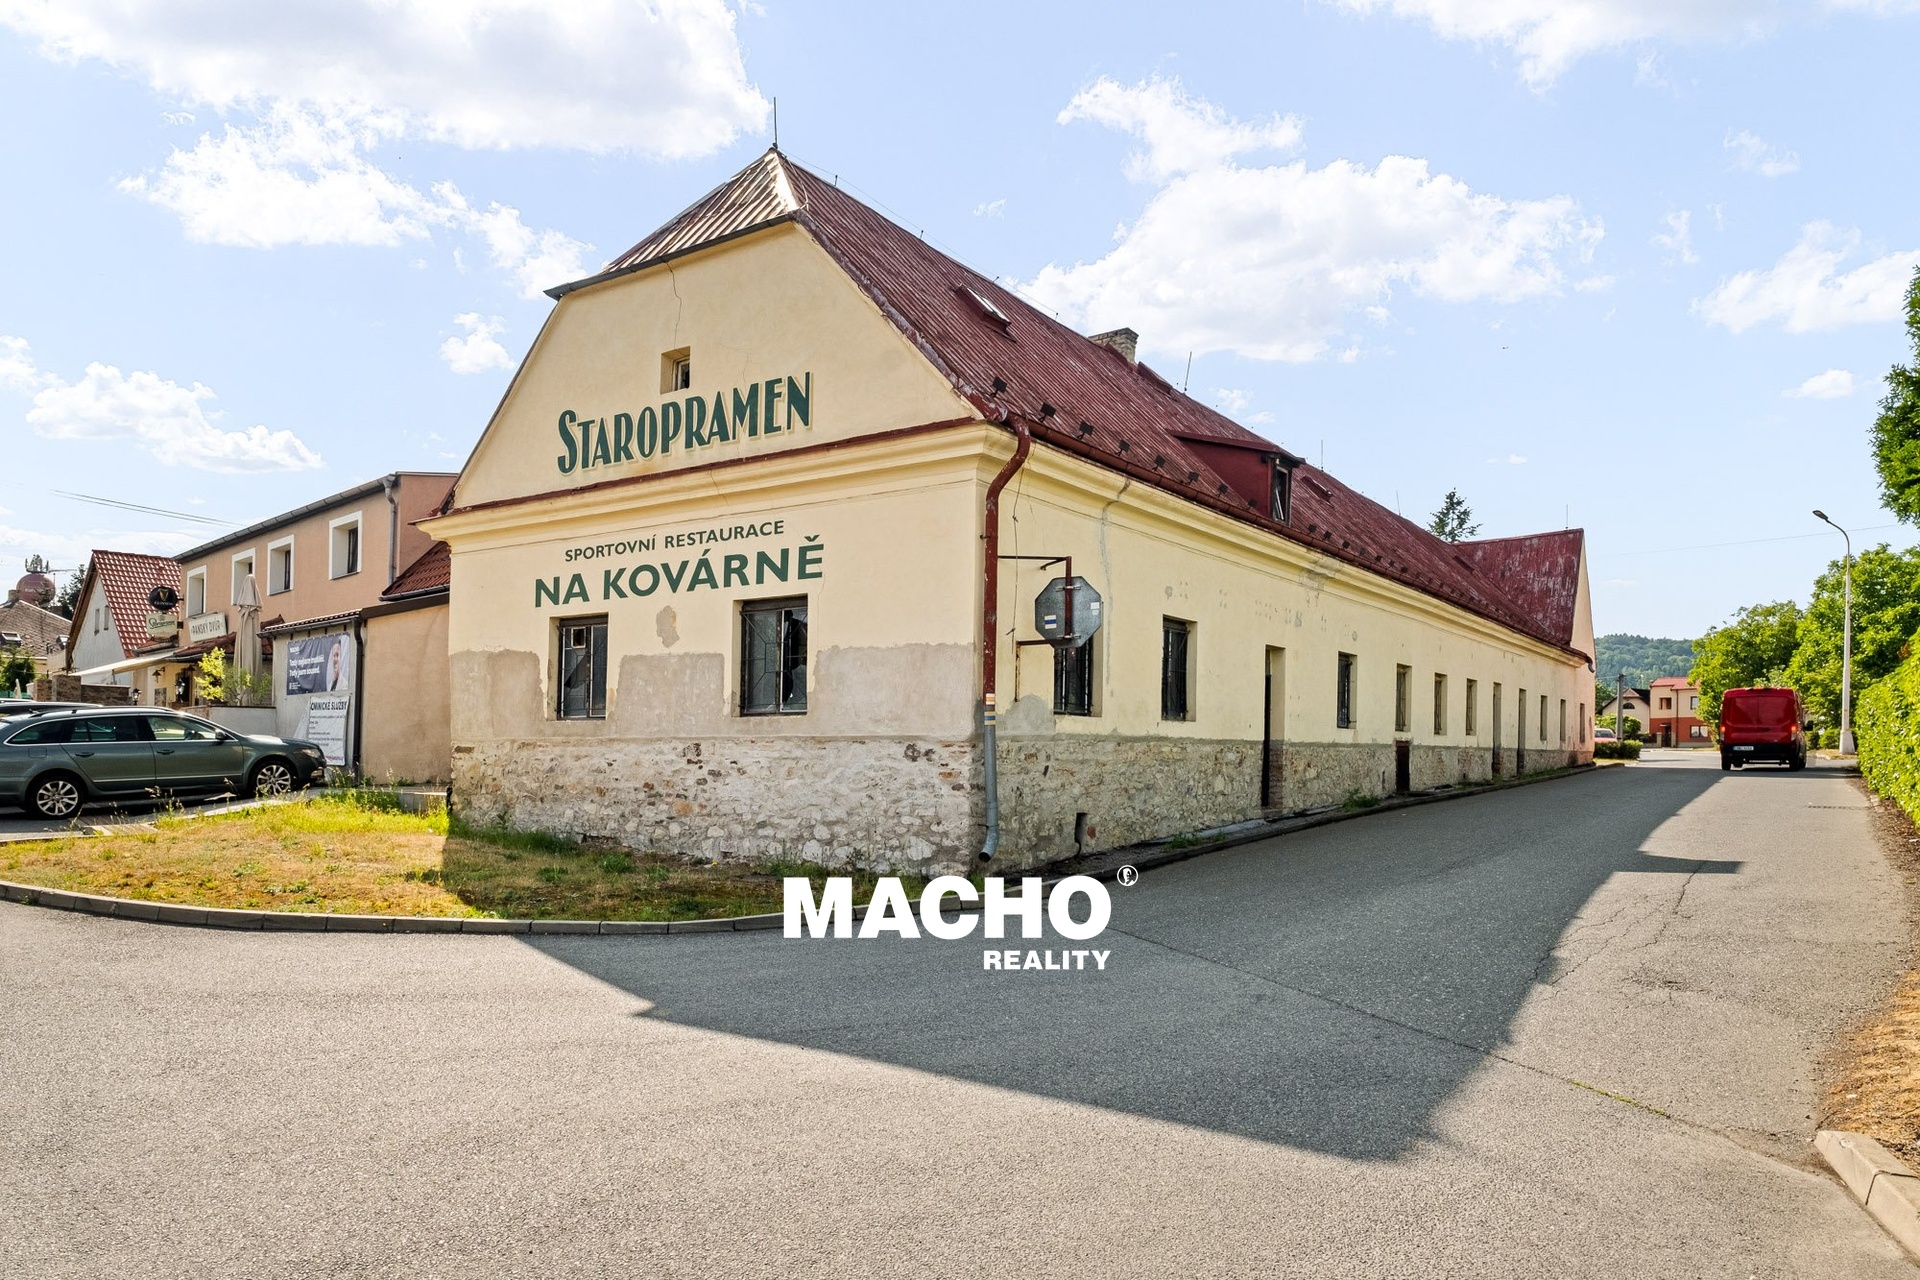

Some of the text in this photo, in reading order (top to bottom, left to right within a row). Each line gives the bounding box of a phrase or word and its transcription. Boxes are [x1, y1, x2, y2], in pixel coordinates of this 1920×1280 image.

[557, 371, 811, 474] STAROPRAMEN
[535, 534, 824, 608] NA KOVÁRNĚ
[565, 520, 785, 562] SPORTOVNÍ RESTAURACE
